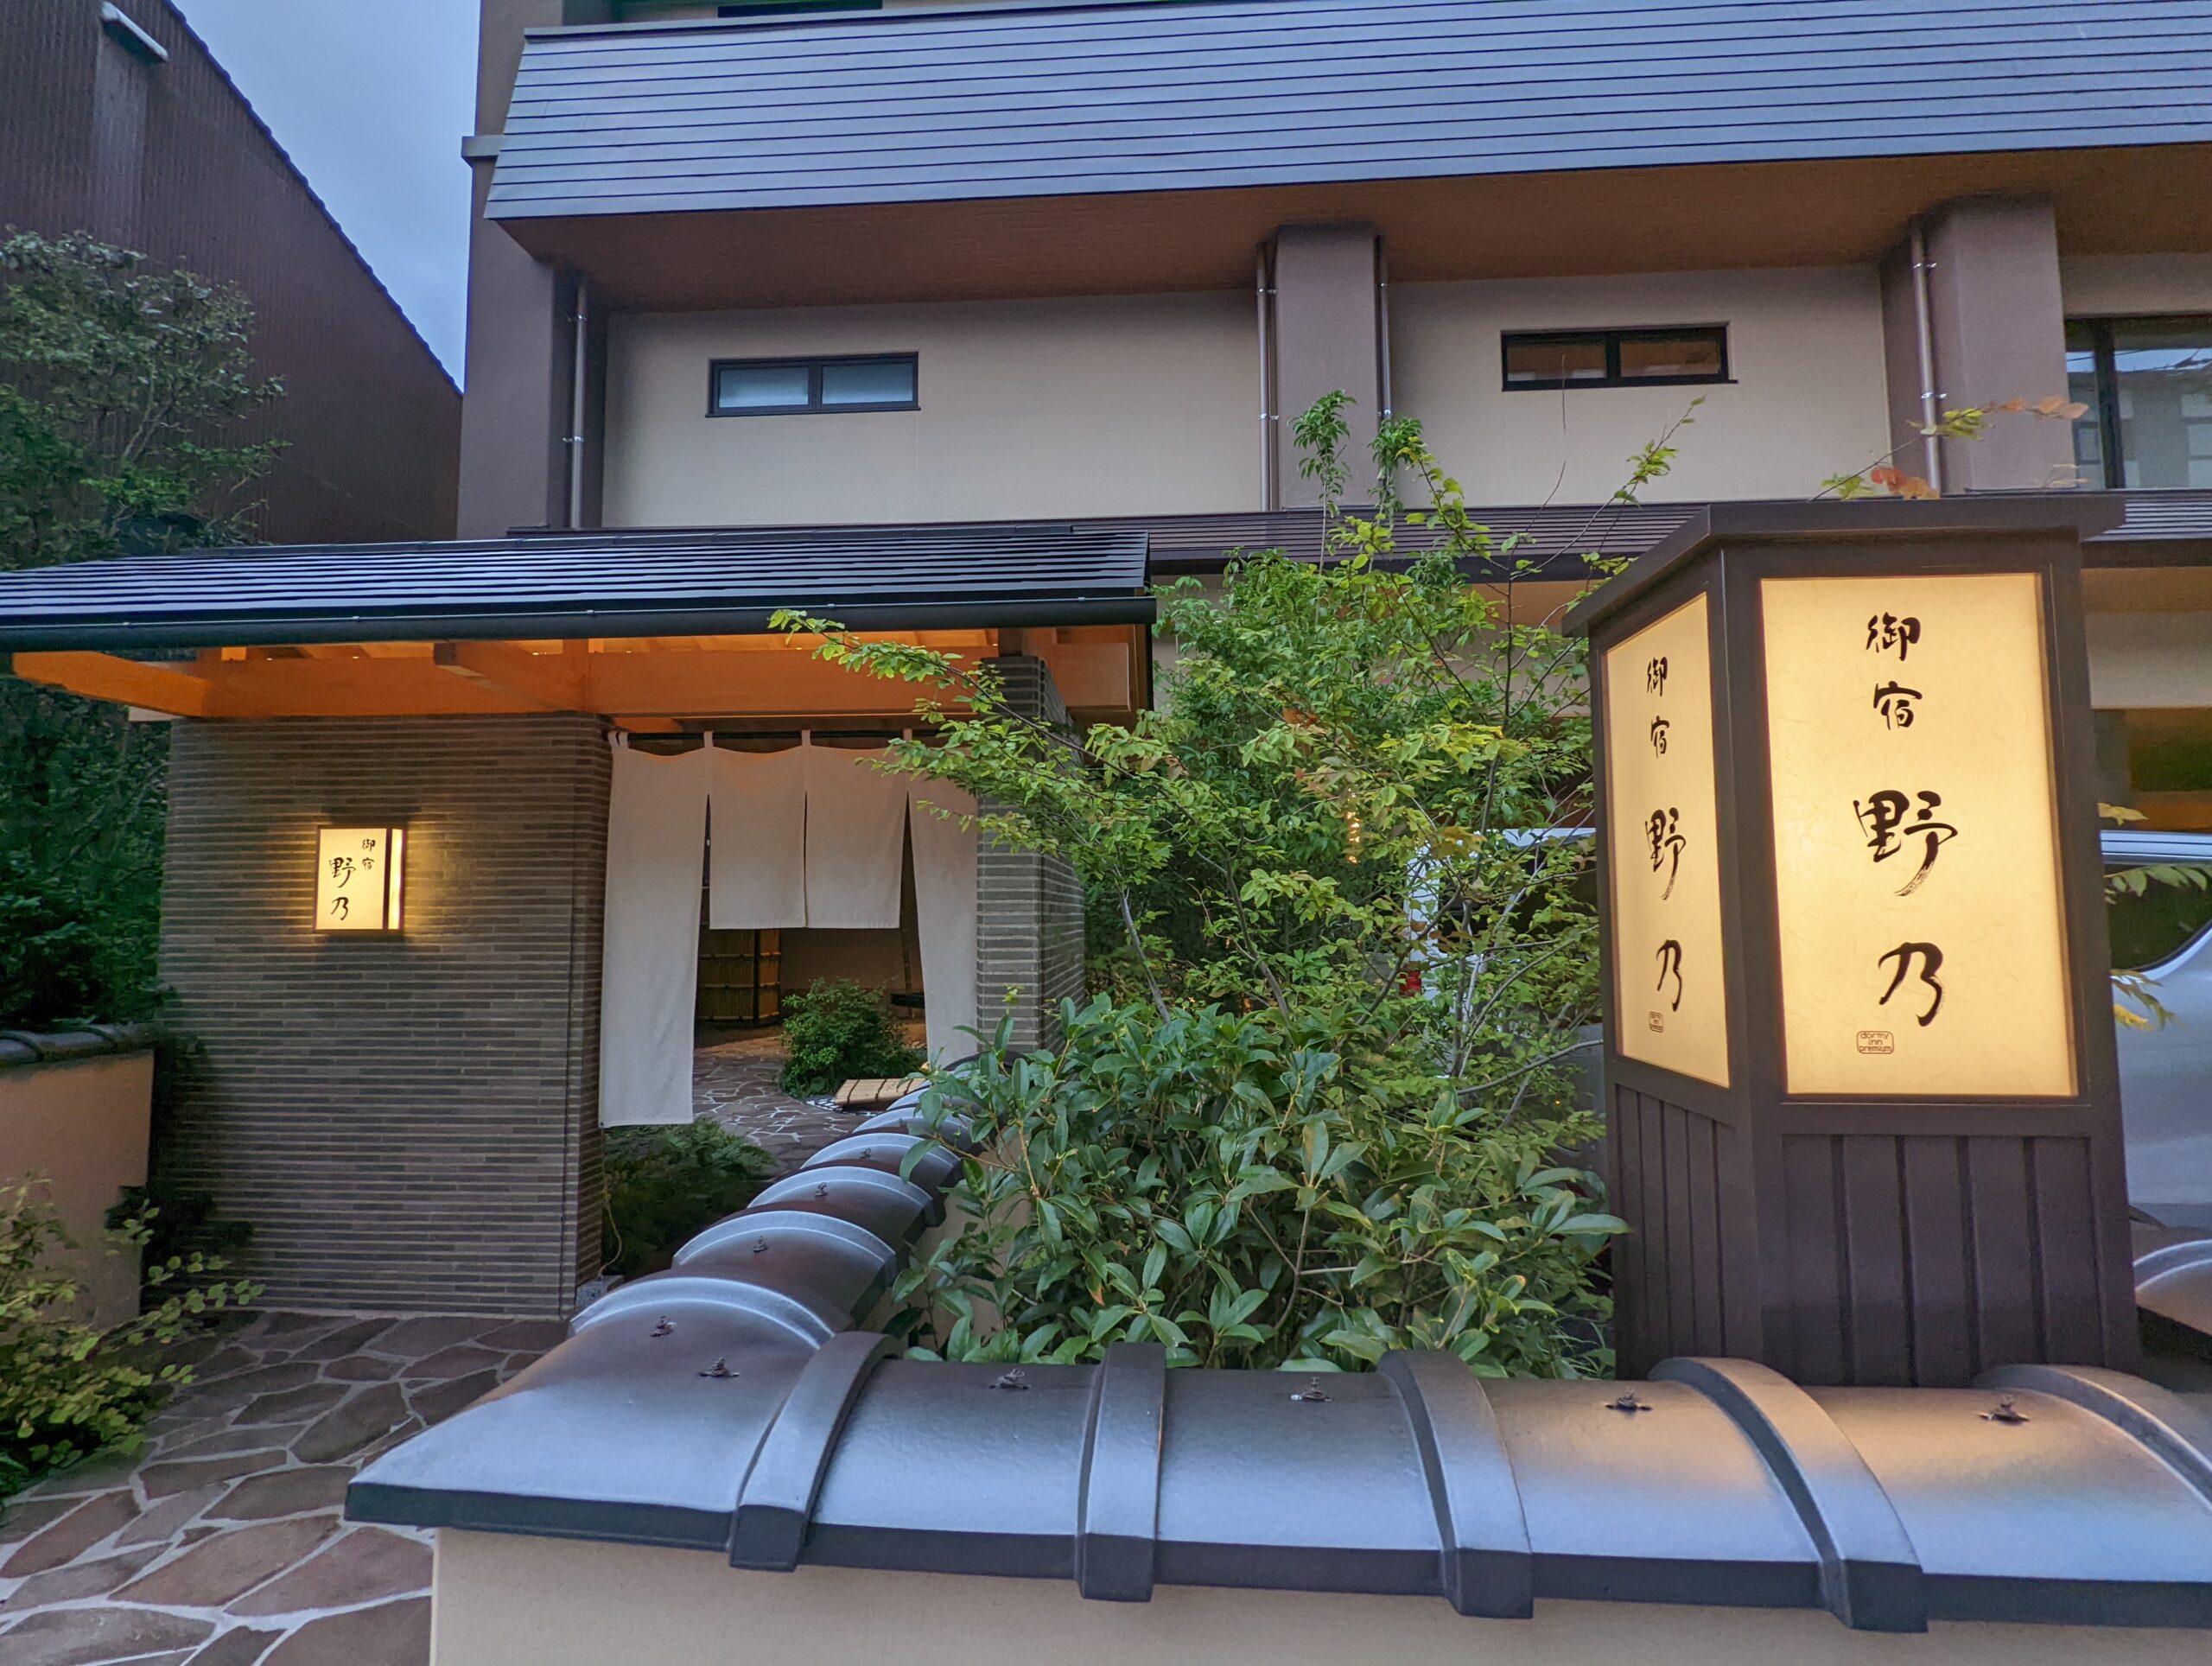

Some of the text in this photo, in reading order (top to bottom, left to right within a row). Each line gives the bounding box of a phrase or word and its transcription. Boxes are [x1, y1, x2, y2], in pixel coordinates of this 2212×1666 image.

[361, 838, 376, 870] 御宿
[329, 856, 356, 921] 野乃
[1859, 1031, 1890, 1040] dormy
